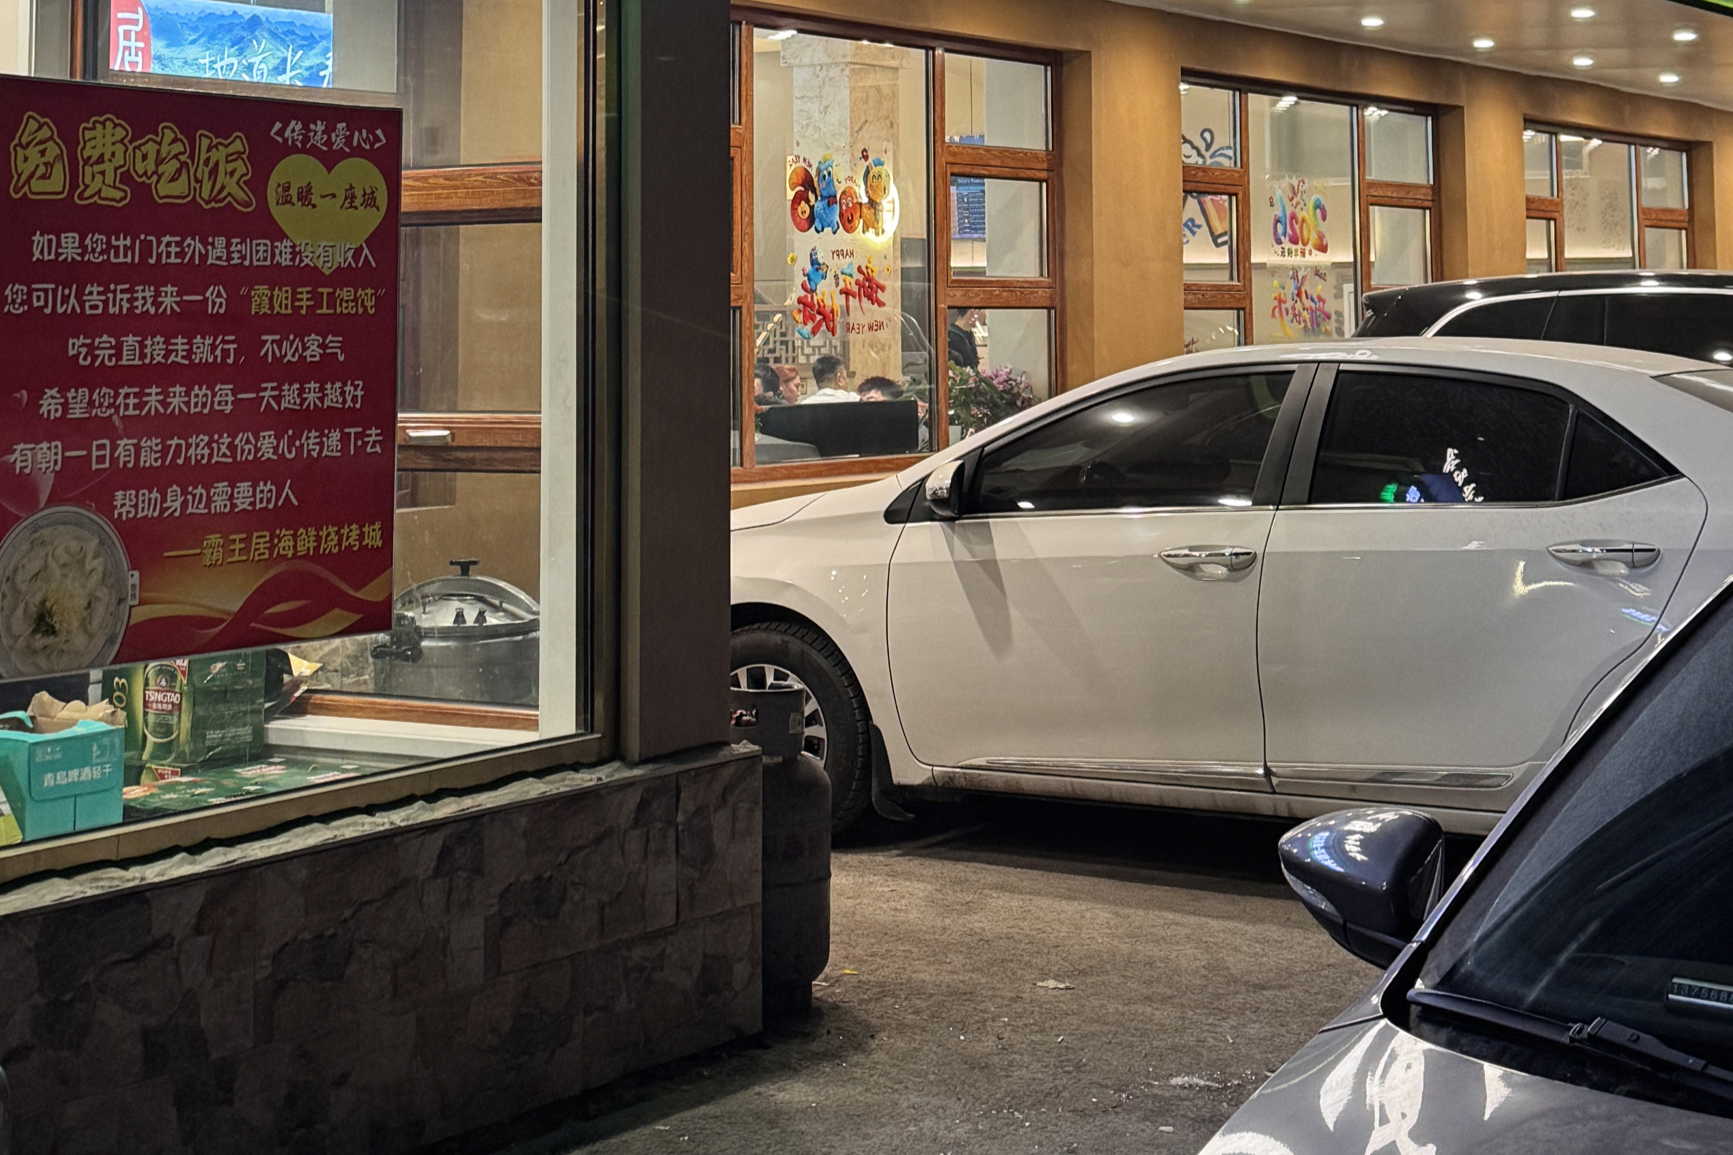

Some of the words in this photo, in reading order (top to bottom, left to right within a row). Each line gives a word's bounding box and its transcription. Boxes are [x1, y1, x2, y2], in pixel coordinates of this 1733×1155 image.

[9, 110, 256, 212] 免费吃饭
[274, 181, 381, 212] 温暖一座城
[31, 230, 377, 269] 如果您出门在外遇到困难没有收入
[38, 379, 366, 421] 希望您在未来的每一天越来越好
[9, 426, 384, 475] 有朝一日有能力将这份爱心传递下去
[113, 478, 299, 521] 帮助身边需要的人
[144, 690, 181, 705] TSINGTAO
